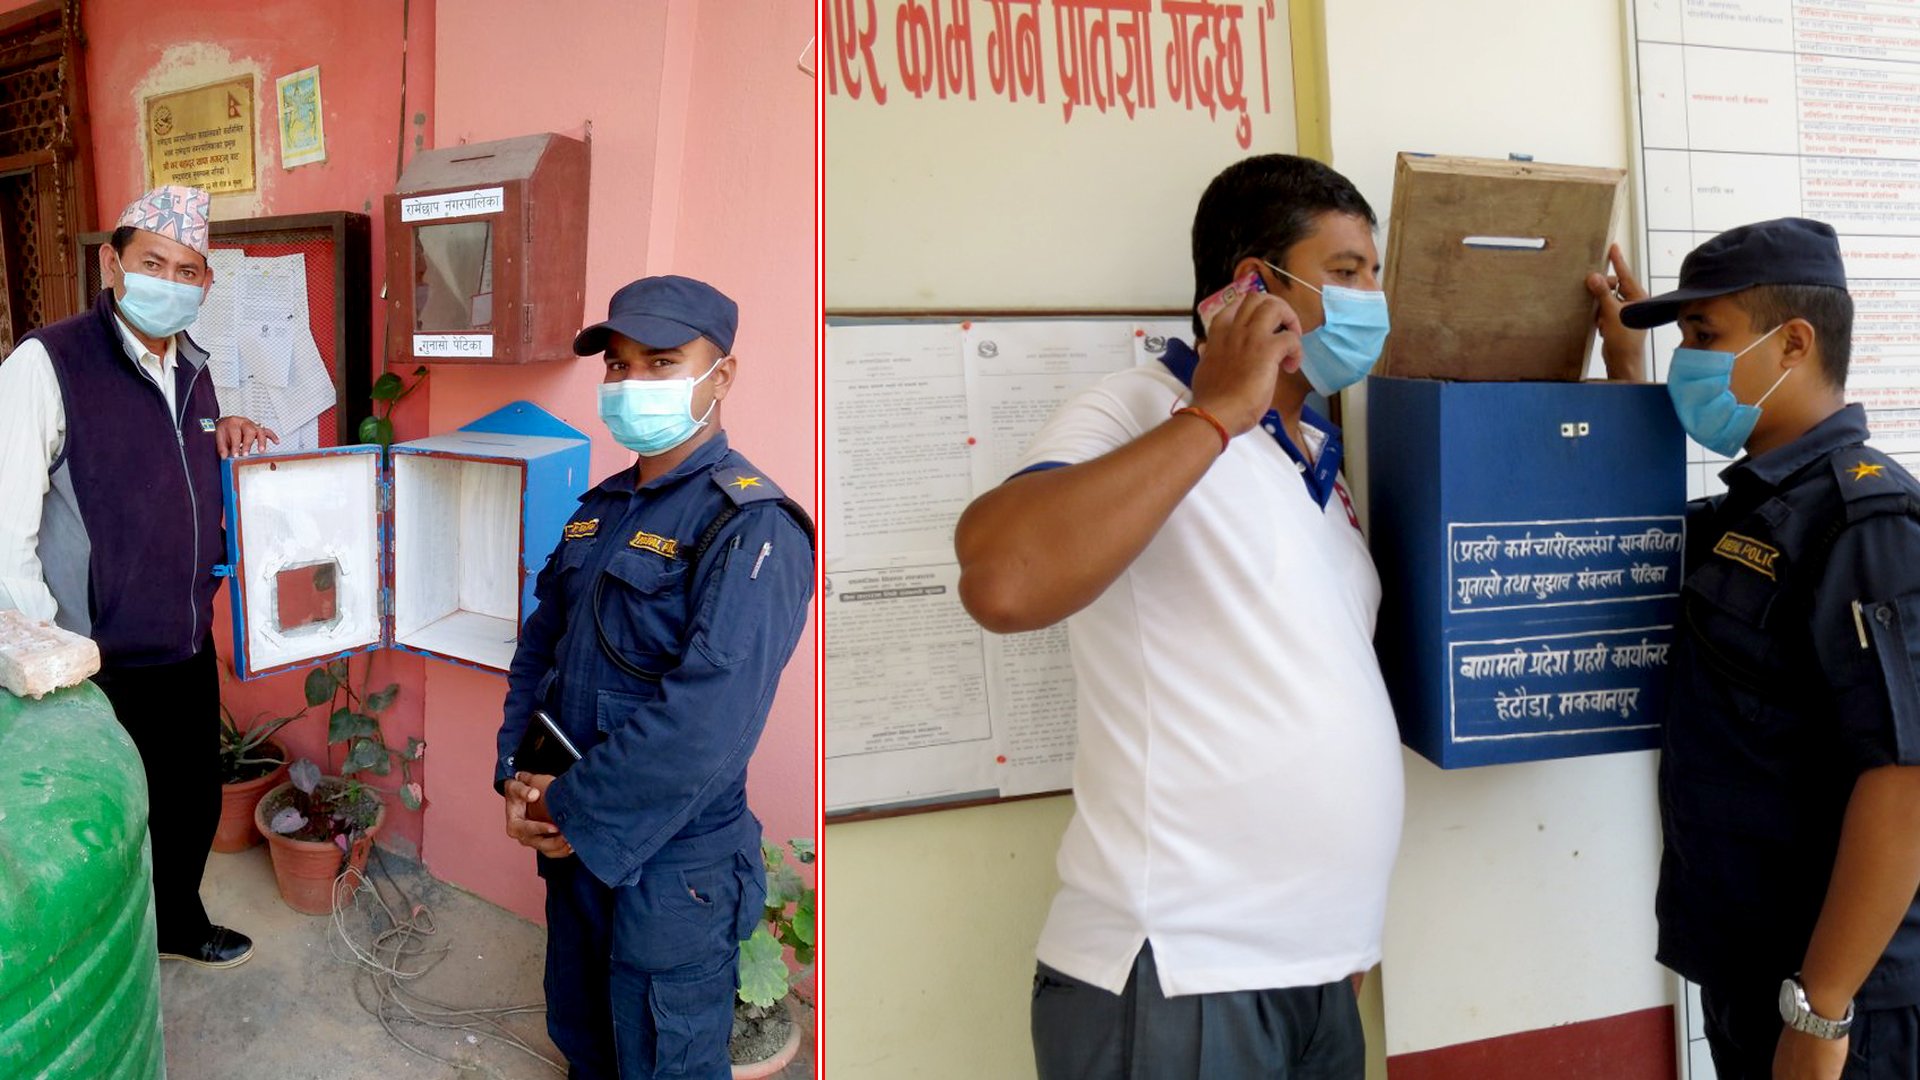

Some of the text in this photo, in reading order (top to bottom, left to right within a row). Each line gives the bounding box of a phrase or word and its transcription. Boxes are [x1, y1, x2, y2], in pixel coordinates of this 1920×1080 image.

[896, 0, 977, 101] काम
[405, 193, 500, 216] रामेछाप नगरपालिका
[422, 336, 482, 354] गुनासो पेटिका
[1741, 543, 1774, 569] POLIC
[1457, 568, 1502, 604] गुनासो
[1503, 574, 1532, 598] तथा
[1630, 562, 1669, 584] पेटिका
[1460, 648, 1528, 680] बागमती
[1528, 644, 1570, 678] प्रदेश
[1574, 642, 1608, 675] प्रहरी
[1558, 688, 1640, 718] मकवानपुर
